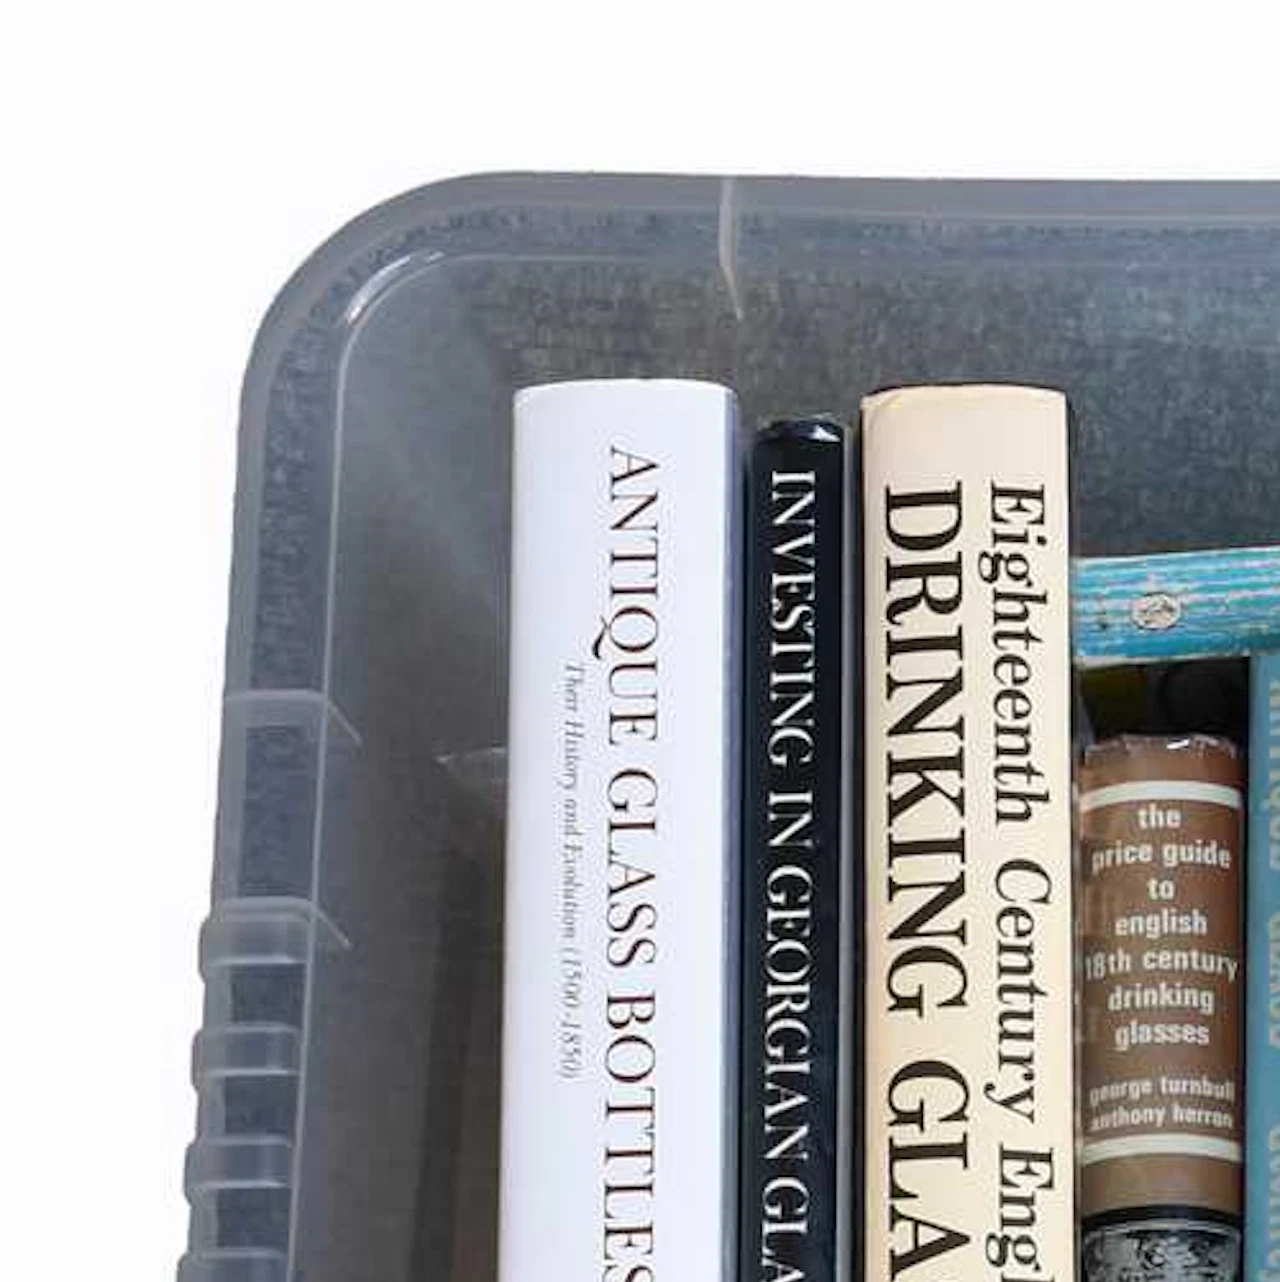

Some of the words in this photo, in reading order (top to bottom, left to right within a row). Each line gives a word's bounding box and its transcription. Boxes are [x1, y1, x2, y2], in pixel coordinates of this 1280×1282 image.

[592, 446, 659, 745] ANTIQUE
[767, 471, 815, 767] INVESTING
[979, 481, 1050, 821] Eighteenth
[885, 481, 968, 1018] DRINKING
[560, 798, 584, 837] and
[767, 790, 812, 848] IN
[1137, 805, 1181, 829] the
[606, 768, 659, 968] GLASS
[1093, 841, 1153, 876] price
[1162, 840, 1231, 871] guide
[1147, 878, 1175, 901] to
[1115, 911, 1207, 939] english
[1085, 950, 1131, 979] 18th
[1142, 948, 1239, 983] century
[983, 859, 1052, 1124] Century
[1107, 987, 1214, 1016] drinking
[763, 867, 812, 1159] GEORGIAN
[1115, 1022, 1210, 1049] glasses
[1090, 1079, 1153, 1106] george
[1161, 1075, 1235, 1101] turnbull
[1092, 1105, 1166, 1130] anthony
